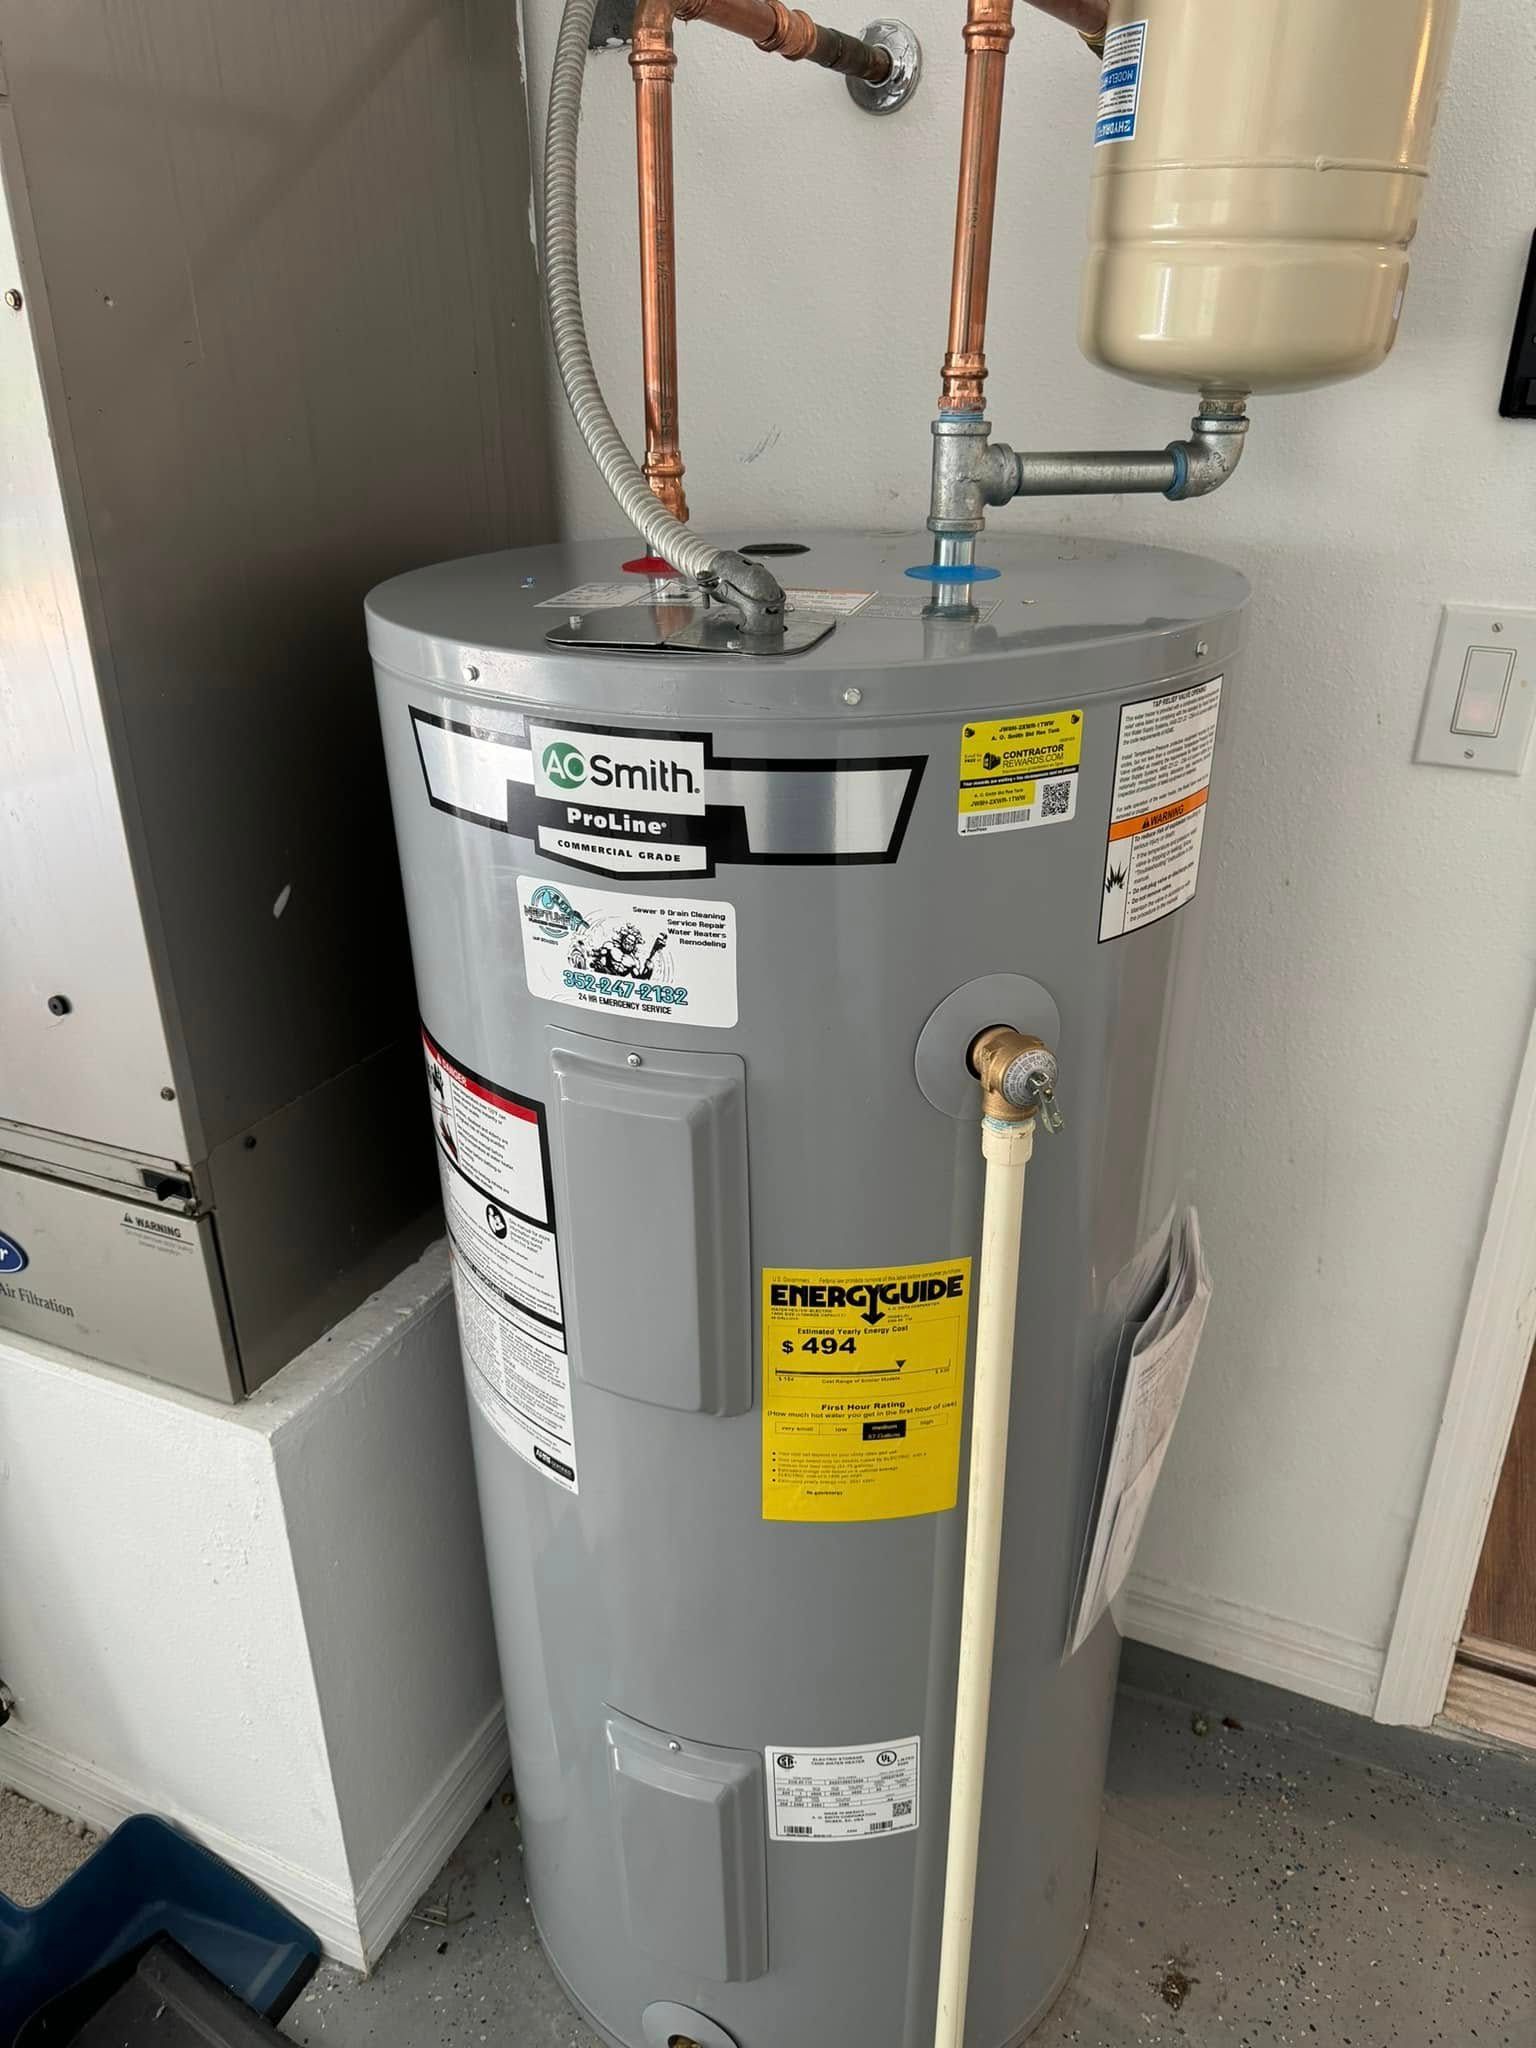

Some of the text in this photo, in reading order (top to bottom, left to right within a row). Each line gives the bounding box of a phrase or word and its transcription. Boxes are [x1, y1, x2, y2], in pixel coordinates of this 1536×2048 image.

[1002, 744, 1065, 760] CONTRACTOR
[1002, 753, 1064, 769] REWARDS.COM
[590, 754, 694, 794] Smith
[567, 807, 662, 835] ProLine
[1151, 804, 1184, 825] WARNING
[558, 839, 681, 862] COMMERCIAL GRADE
[633, 906, 656, 915] Sewer
[667, 909, 689, 917] Drain
[690, 911, 726, 921] Cleaning
[667, 919, 725, 929] Service Repair
[667, 928, 727, 939] Water Heaters
[680, 938, 726, 949] Remodeling
[563, 969, 689, 1006] 352-247-2132
[578, 993, 672, 1014] 24 HR EMERGENCY SERVICE
[135, 1216, 182, 1238] WARNING
[770, 1274, 964, 1310] ENERGYGUIDE
[18, 1288, 75, 1318] Filtration
[798, 1324, 908, 1336] Estimated Yearly Energy Cost
[781, 1337, 857, 1356] $ 494
[767, 1410, 786, 1418] (How
[847, 1412, 862, 1420] you
[863, 1411, 875, 1419] get
[914, 1405, 932, 1413] hour
[847, 1403, 870, 1411] Hour
[874, 1400, 906, 1411] Rating
